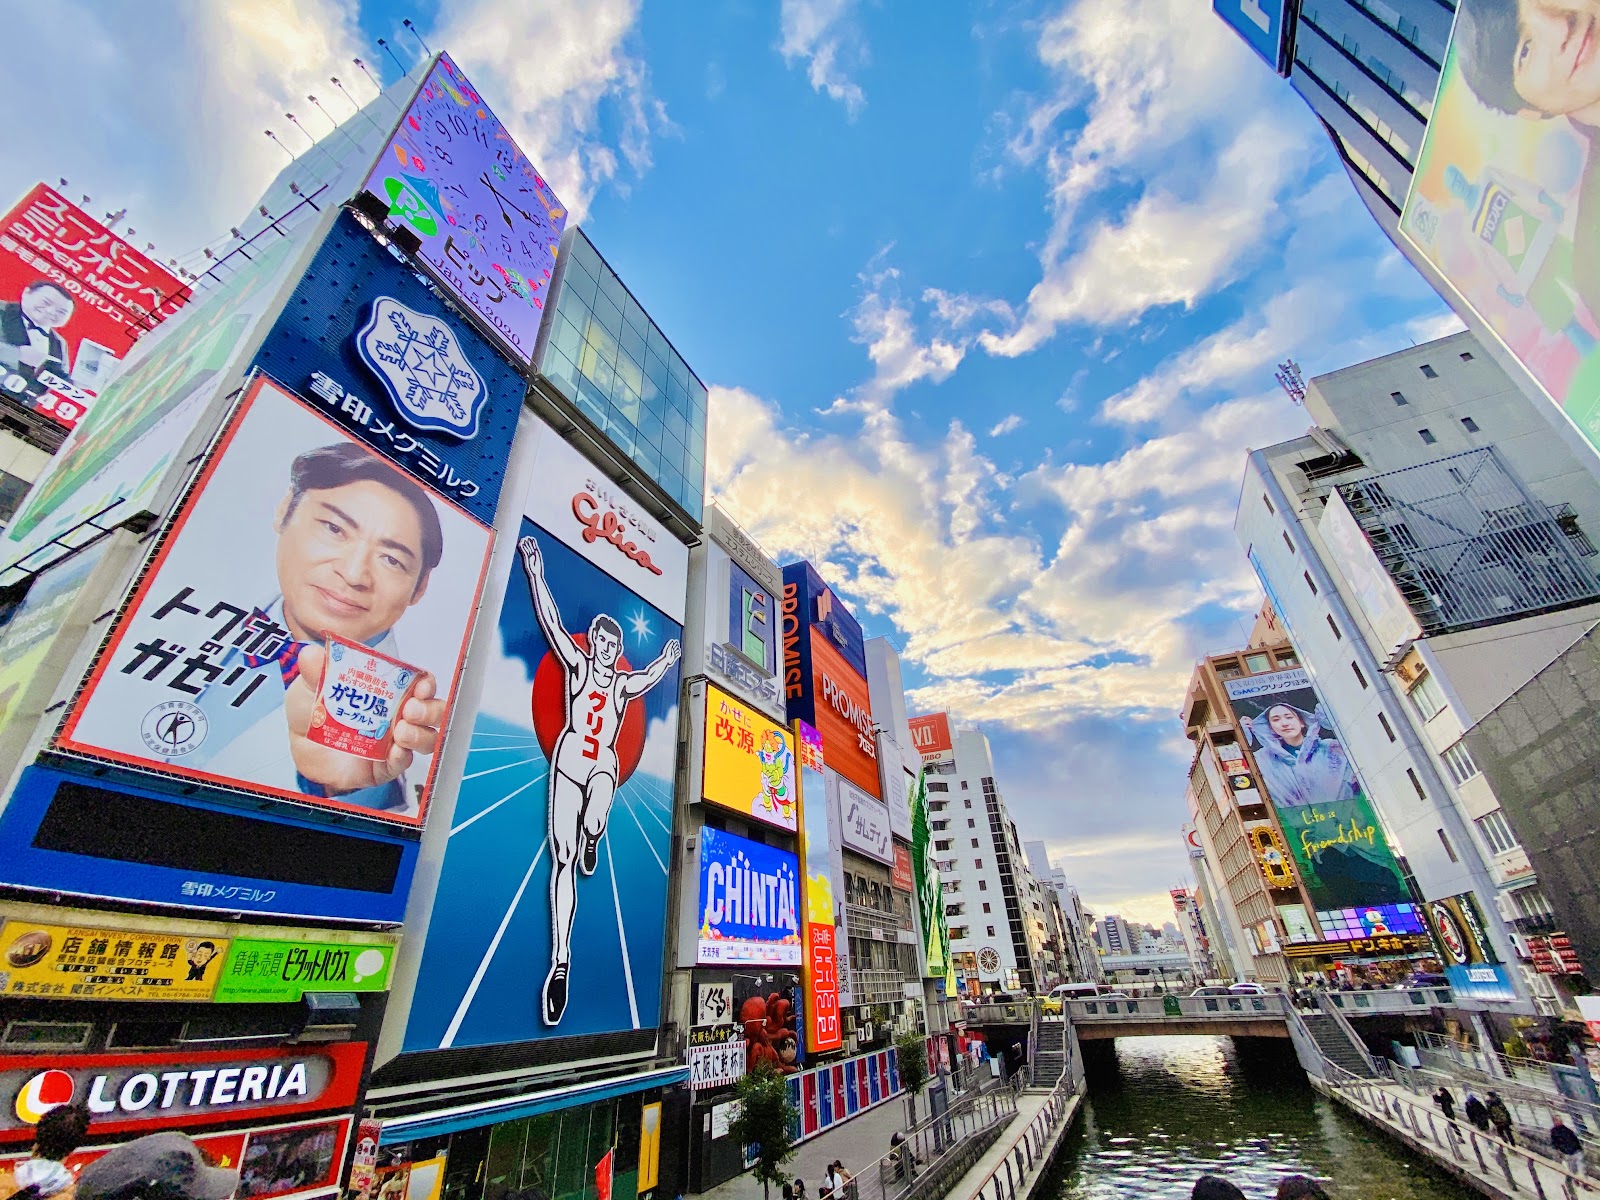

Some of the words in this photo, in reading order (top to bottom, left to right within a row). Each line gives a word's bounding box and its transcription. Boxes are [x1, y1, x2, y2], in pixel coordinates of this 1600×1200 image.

[435, 120, 451, 142] 9
[448, 113, 468, 136] 10
[472, 125, 488, 149] 11
[435, 146, 452, 165] 8
[45, 190, 149, 274] スーパー
[475, 214, 487, 231] 6
[8, 222, 82, 275] SUPER
[520, 241, 532, 258] 4
[529, 232, 541, 250] 3
[444, 234, 507, 303] ピップ
[43, 376, 84, 399] ルアン
[310, 370, 479, 497] 雪印メグミルク
[571, 492, 663, 576] Glico
[151, 586, 291, 659] トクホ
[199, 641, 223, 656] の
[782, 582, 803, 699] PROMISE
[120, 638, 267, 708] ガセリ
[335, 707, 374, 726] ヨーグルト
[719, 700, 752, 728] かぜに
[823, 672, 876, 742] PROMISE
[582, 690, 609, 761] グリコ
[715, 714, 755, 756] 改源
[909, 725, 936, 748] .V.D.
[1302, 809, 1325, 824] Life
[180, 880, 276, 903] 雪印メグミルク
[67, 929, 97, 938] KANSAI
[60, 936, 180, 960] 店舗情報館
[281, 947, 351, 982] ピタットハウス
[13, 980, 64, 994] 株式会社
[87, 1063, 308, 1114] LOTTERIA
